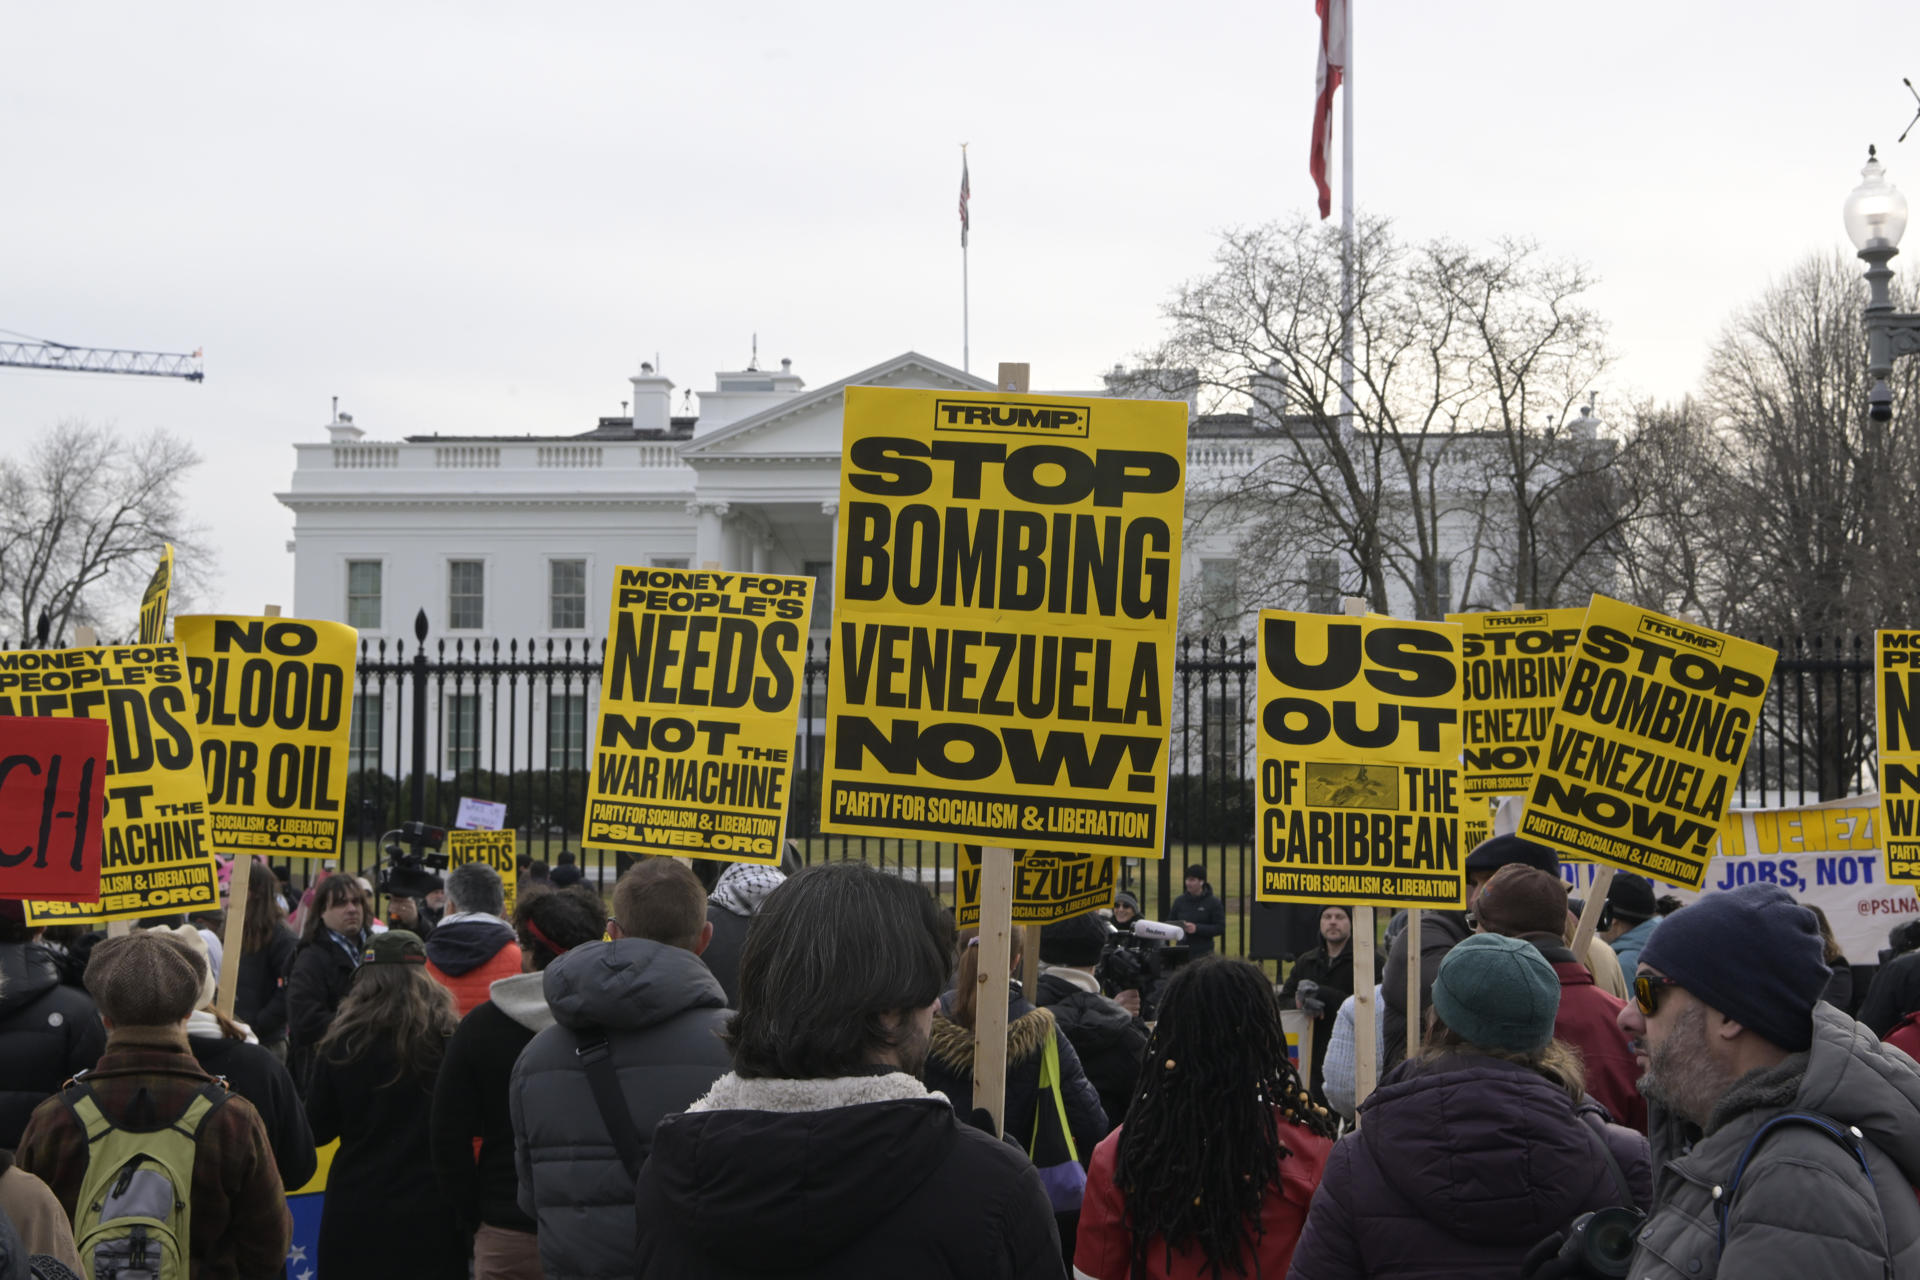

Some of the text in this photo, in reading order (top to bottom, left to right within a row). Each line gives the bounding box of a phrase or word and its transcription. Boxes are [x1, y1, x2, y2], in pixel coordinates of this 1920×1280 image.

[941, 404, 1084, 431] TRUMP:
[848, 436, 1180, 508] STOP
[844, 501, 1170, 620] BOMBING
[618, 588, 804, 620] PEOPLE'S
[620, 569, 808, 597] MONEY FOR
[214, 620, 318, 656] NO
[1463, 629, 1581, 657] STOP
[1644, 618, 1720, 653] TRUMP:
[0, 646, 179, 670] MONEY FOR
[0, 665, 182, 692] PEOPLE'S
[609, 611, 800, 713] NEEDS
[841, 621, 1162, 726] VENEZUELA
[1264, 618, 1457, 698] US
[1463, 656, 1573, 700] OMBIN
[1582, 624, 1765, 699] STOP
[186, 656, 344, 732] BLOOD
[1562, 658, 1750, 766] BOMBING
[601, 713, 788, 763] NOT THE
[1262, 697, 1458, 753] OUT
[1463, 706, 1556, 744] ENEZU
[200, 739, 258, 806] OR
[267, 743, 339, 812] OIL
[834, 715, 1163, 793] NOW!
[1464, 746, 1541, 771] NO
[1547, 723, 1728, 822] VENEZUELA
[598, 753, 786, 810] WAR MACHINE
[1262, 758, 1459, 814] OF THE
[1464, 777, 1483, 791] ARTY
[1483, 777, 1497, 790] FOR
[155, 802, 204, 817] THE
[216, 814, 264, 832] SOCIALISM
[266, 818, 279, 831] &
[280, 819, 335, 836] LIBERATION
[593, 803, 777, 837] PARTY FOR SOCIALISM & LIBERATION
[835, 790, 1149, 839] PARTY FOR SOCIALISM & LIBERATION
[1532, 774, 1717, 857] NOW!
[1754, 807, 1882, 855] VENEZ
[102, 818, 209, 868] ACHINE
[212, 830, 333, 850] WEB.ORG
[452, 844, 513, 872] NEEDS
[591, 823, 773, 855] PSLWEB.ORG
[1263, 807, 1459, 871] CARIBBEAN
[1526, 815, 1558, 838] PARTY
[1557, 825, 1578, 843] FOR
[1577, 830, 1631, 860] SOCIALISM
[1629, 849, 1642, 864] &
[1642, 852, 1699, 881] LIBERATION
[100, 868, 210, 894] ALISM & LIBERATION
[962, 856, 1112, 904] VEZUELA
[1027, 859, 1056, 868] ON
[1265, 872, 1457, 898] PARTY FOR SOCIALISM & LIBERATION
[1717, 859, 1806, 892] JOBS,
[1816, 856, 1876, 885] NOT
[962, 908, 981, 921] PAR
[1055, 905, 1065, 916] &
[1065, 892, 1109, 913] LIBERATION
